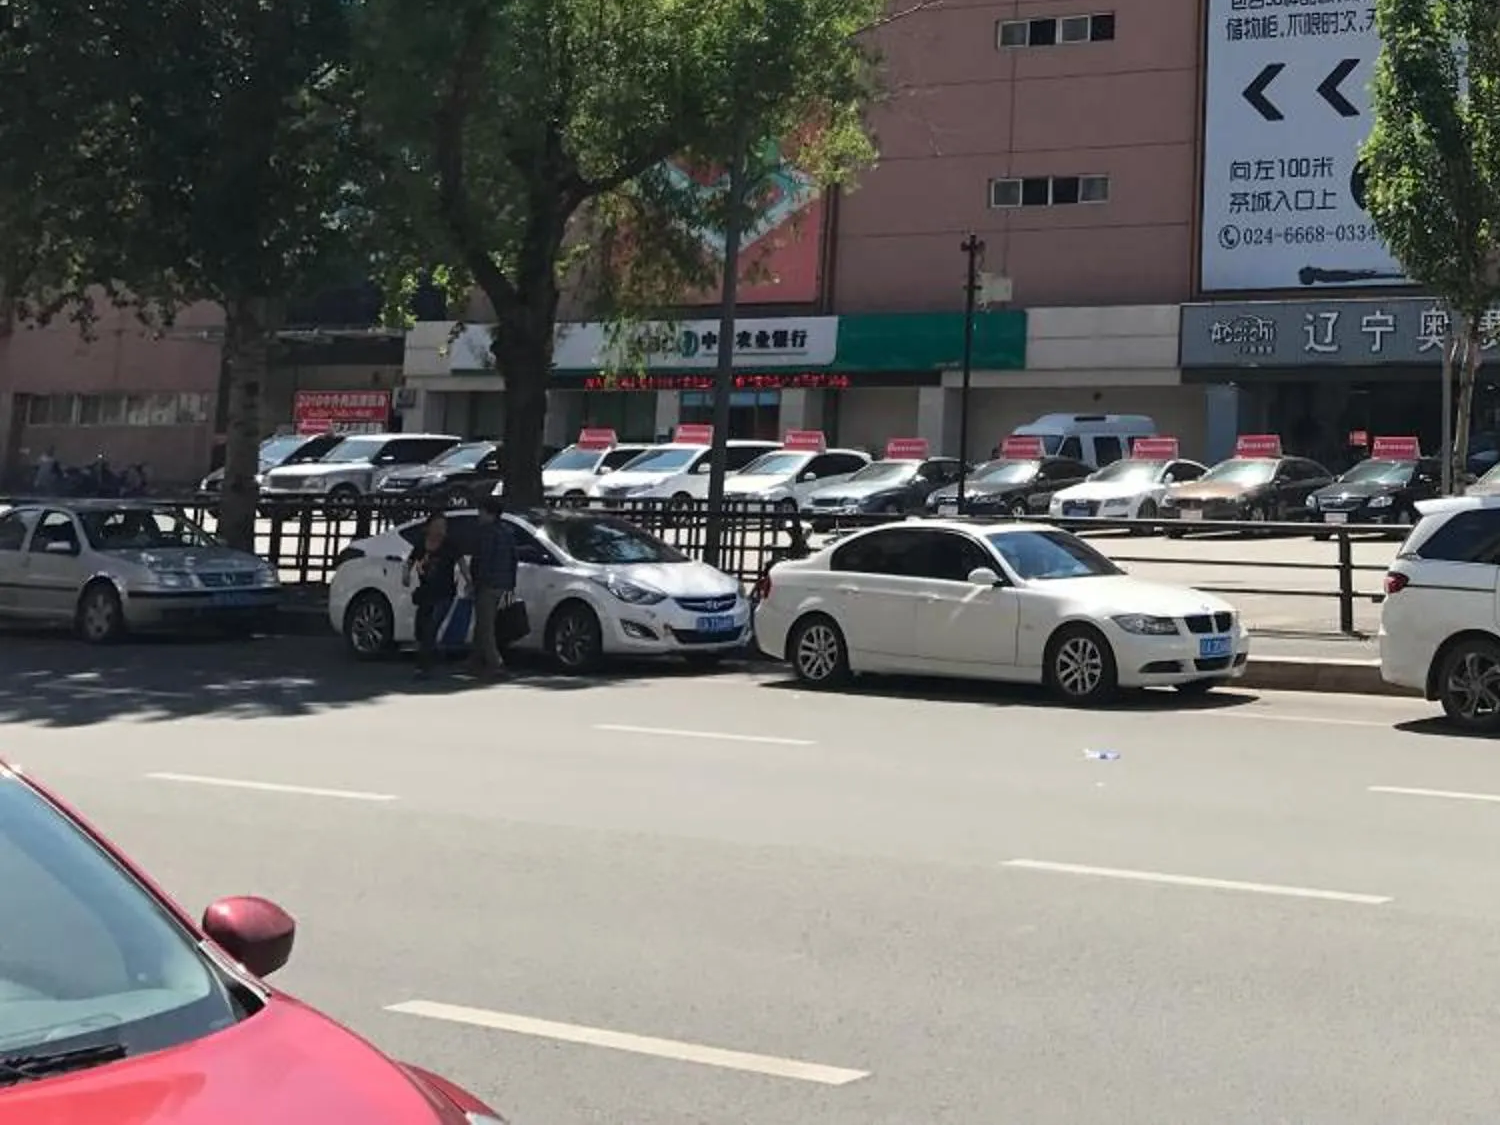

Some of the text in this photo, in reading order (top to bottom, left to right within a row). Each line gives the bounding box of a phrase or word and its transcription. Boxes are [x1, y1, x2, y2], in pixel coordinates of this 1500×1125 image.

[1229, 156, 1335, 183] 向左100米
[701, 330, 807, 350] 中农业银行
